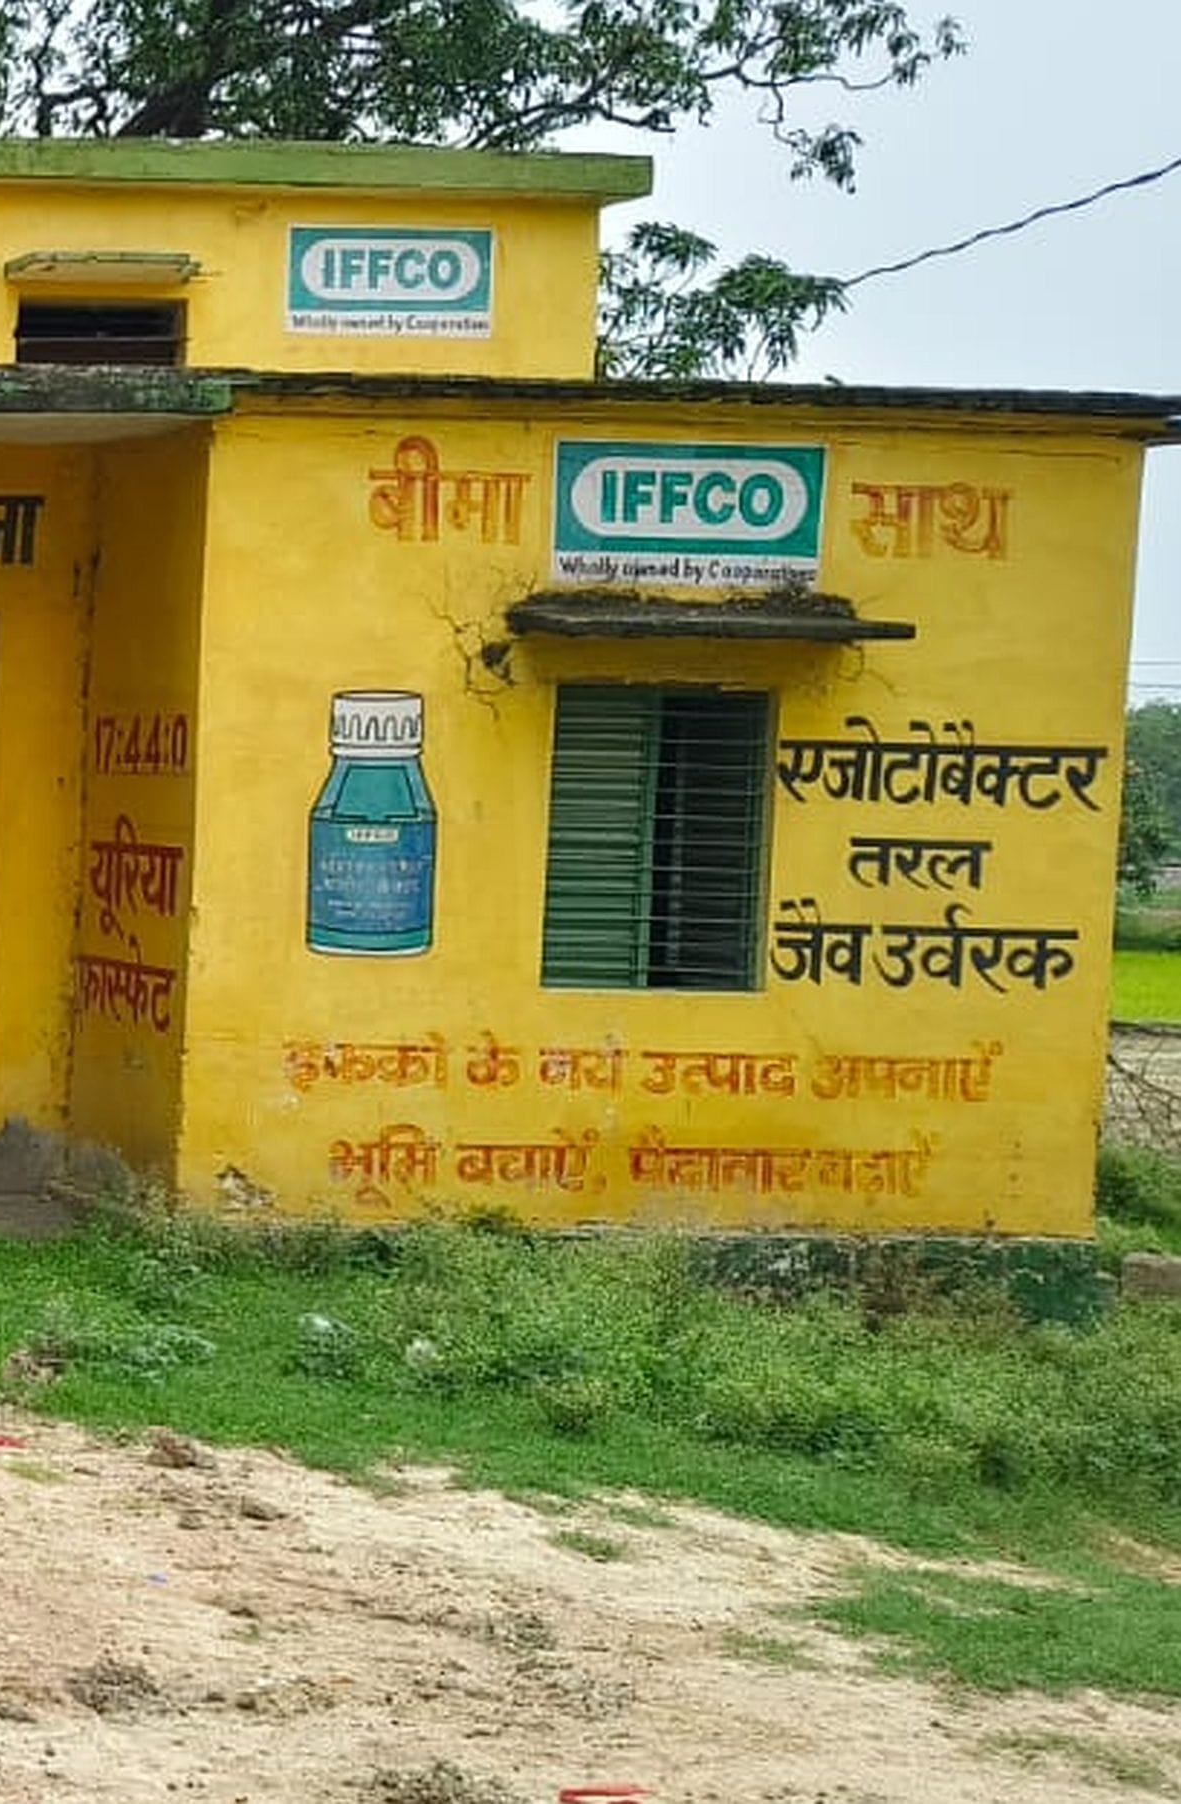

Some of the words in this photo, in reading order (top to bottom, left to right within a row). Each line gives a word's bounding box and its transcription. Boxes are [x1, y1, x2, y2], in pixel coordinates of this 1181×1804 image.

[321, 246, 463, 290] IFFCO
[367, 435, 531, 545] बीमा
[850, 481, 1013, 560] साथ
[600, 470, 785, 526] IFFCO
[559, 556, 618, 577] Wholly
[683, 557, 703, 583] by
[778, 716, 1108, 812] एजोटोबैक्टर
[90, 813, 183, 940] यूरिया
[848, 837, 992, 890] तरल
[770, 898, 873, 986] जैव
[872, 903, 1078, 994] उर्वरक
[466, 1030, 520, 1087] के
[641, 1051, 798, 1099] उत्पाद
[328, 1124, 441, 1208] भूमि
